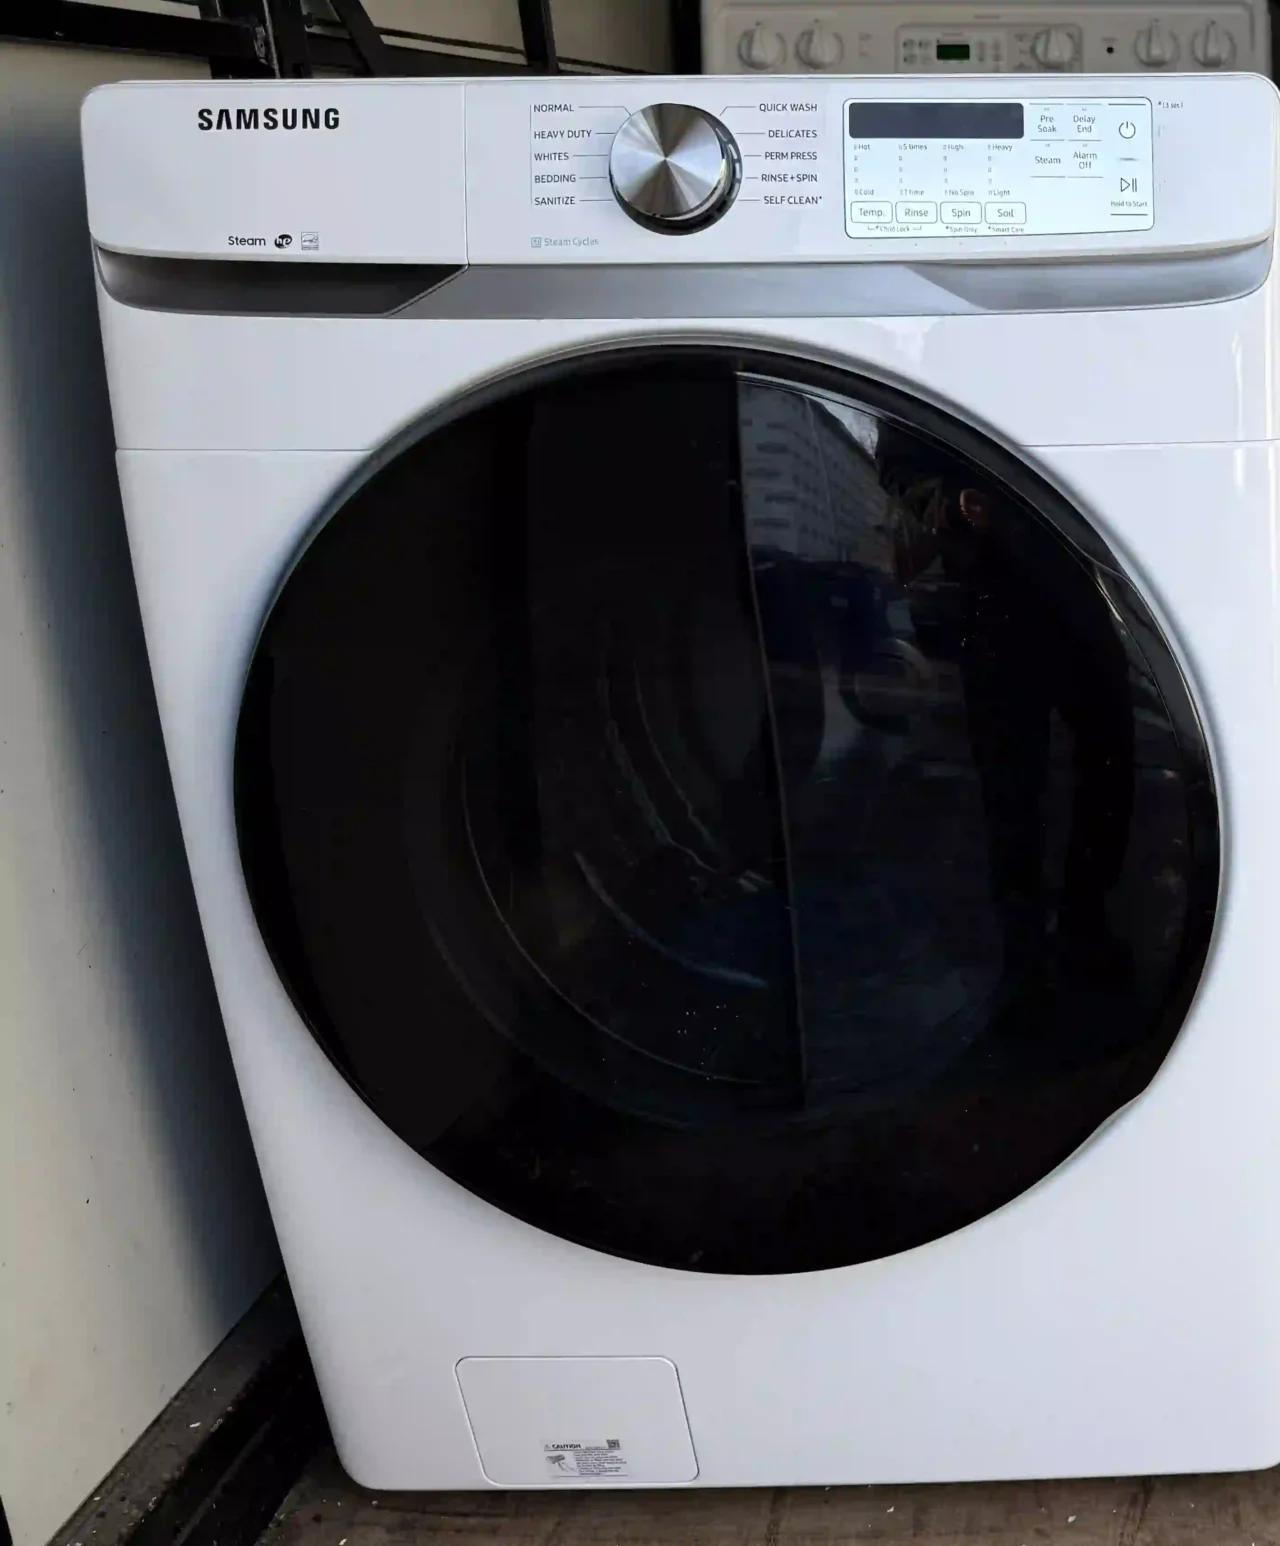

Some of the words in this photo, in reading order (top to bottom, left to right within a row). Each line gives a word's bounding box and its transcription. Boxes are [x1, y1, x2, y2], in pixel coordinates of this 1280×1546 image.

[533, 103, 574, 113] NORMAL
[758, 103, 788, 113] QUICK
[790, 103, 818, 112] WASH
[197, 107, 340, 131] SAMSUNG
[1040, 114, 1054, 123] Pre
[1072, 114, 1096, 124] Delay
[1037, 125, 1057, 133] Soak
[1076, 124, 1092, 133] End
[533, 129, 565, 139] HEAVY
[566, 129, 592, 139] DUTY
[768, 129, 818, 139] DELICATES
[992, 143, 1013, 152] Heavy
[533, 152, 569, 161] WHITES
[764, 151, 788, 161] PERM
[789, 151, 818, 161] PRESS
[1072, 151, 1098, 160] Alarm
[1034, 156, 1061, 165] Steam
[1078, 161, 1092, 170] Off
[534, 174, 577, 183] BEDDING
[993, 189, 1010, 197] Light
[534, 196, 576, 205] SANITIZE
[763, 196, 786, 205] SELF
[859, 208, 885, 218] Temp.
[904, 208, 929, 217] Rinse
[951, 208, 971, 219] Spin
[997, 208, 1015, 218] Soil
[227, 235, 266, 246] Steam
[544, 237, 571, 247] Steam
[572, 237, 599, 247] Cycles
